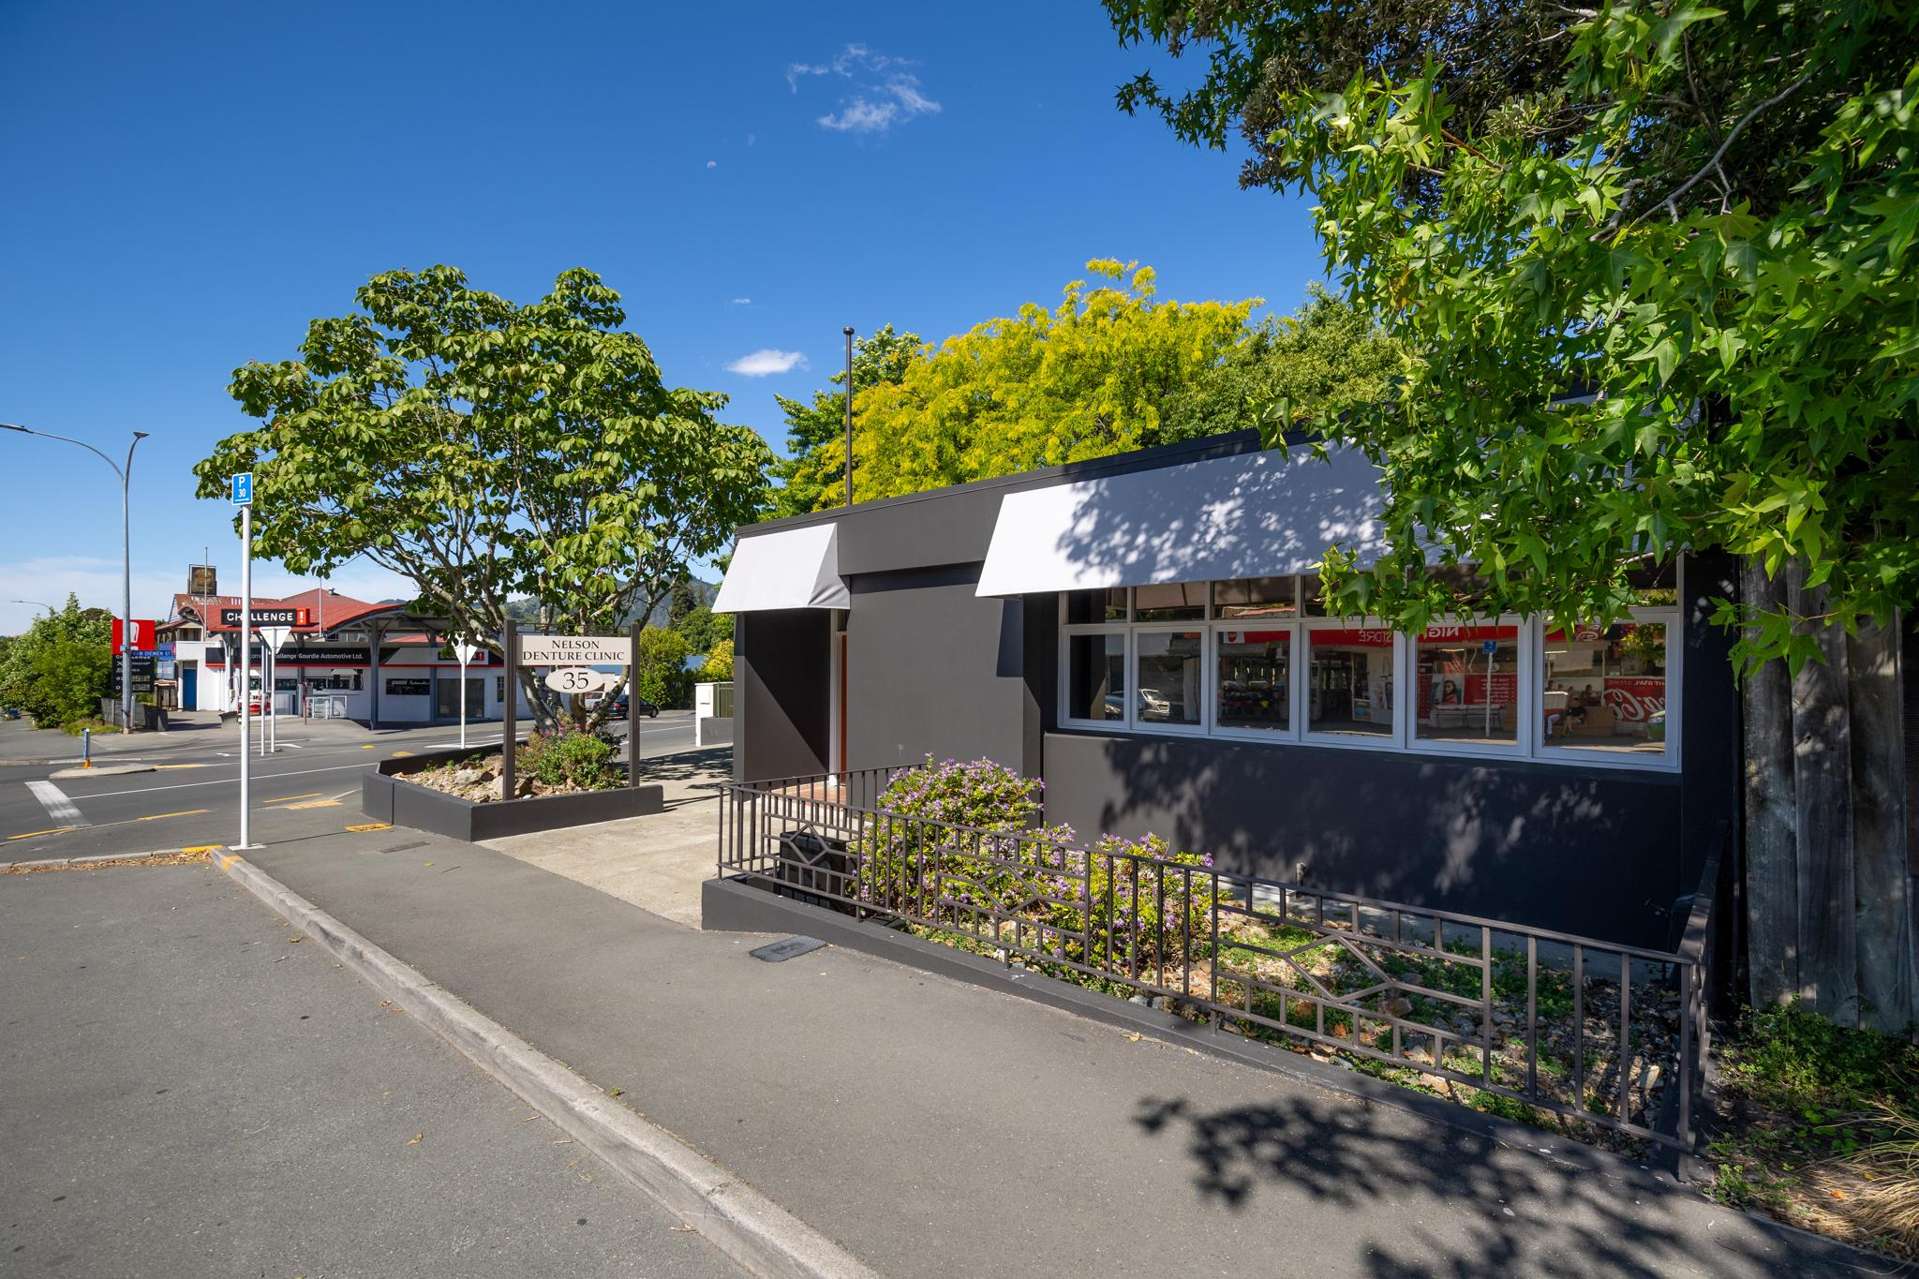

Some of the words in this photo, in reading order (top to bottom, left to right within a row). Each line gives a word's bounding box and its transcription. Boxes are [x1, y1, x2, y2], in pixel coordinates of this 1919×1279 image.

[238, 476, 246, 488] P
[226, 612, 293, 622] CHLLENGE
[551, 640, 600, 649] NELSON
[523, 651, 582, 660] DENTURE
[584, 651, 624, 660] CLINIC
[562, 672, 590, 691] 35
